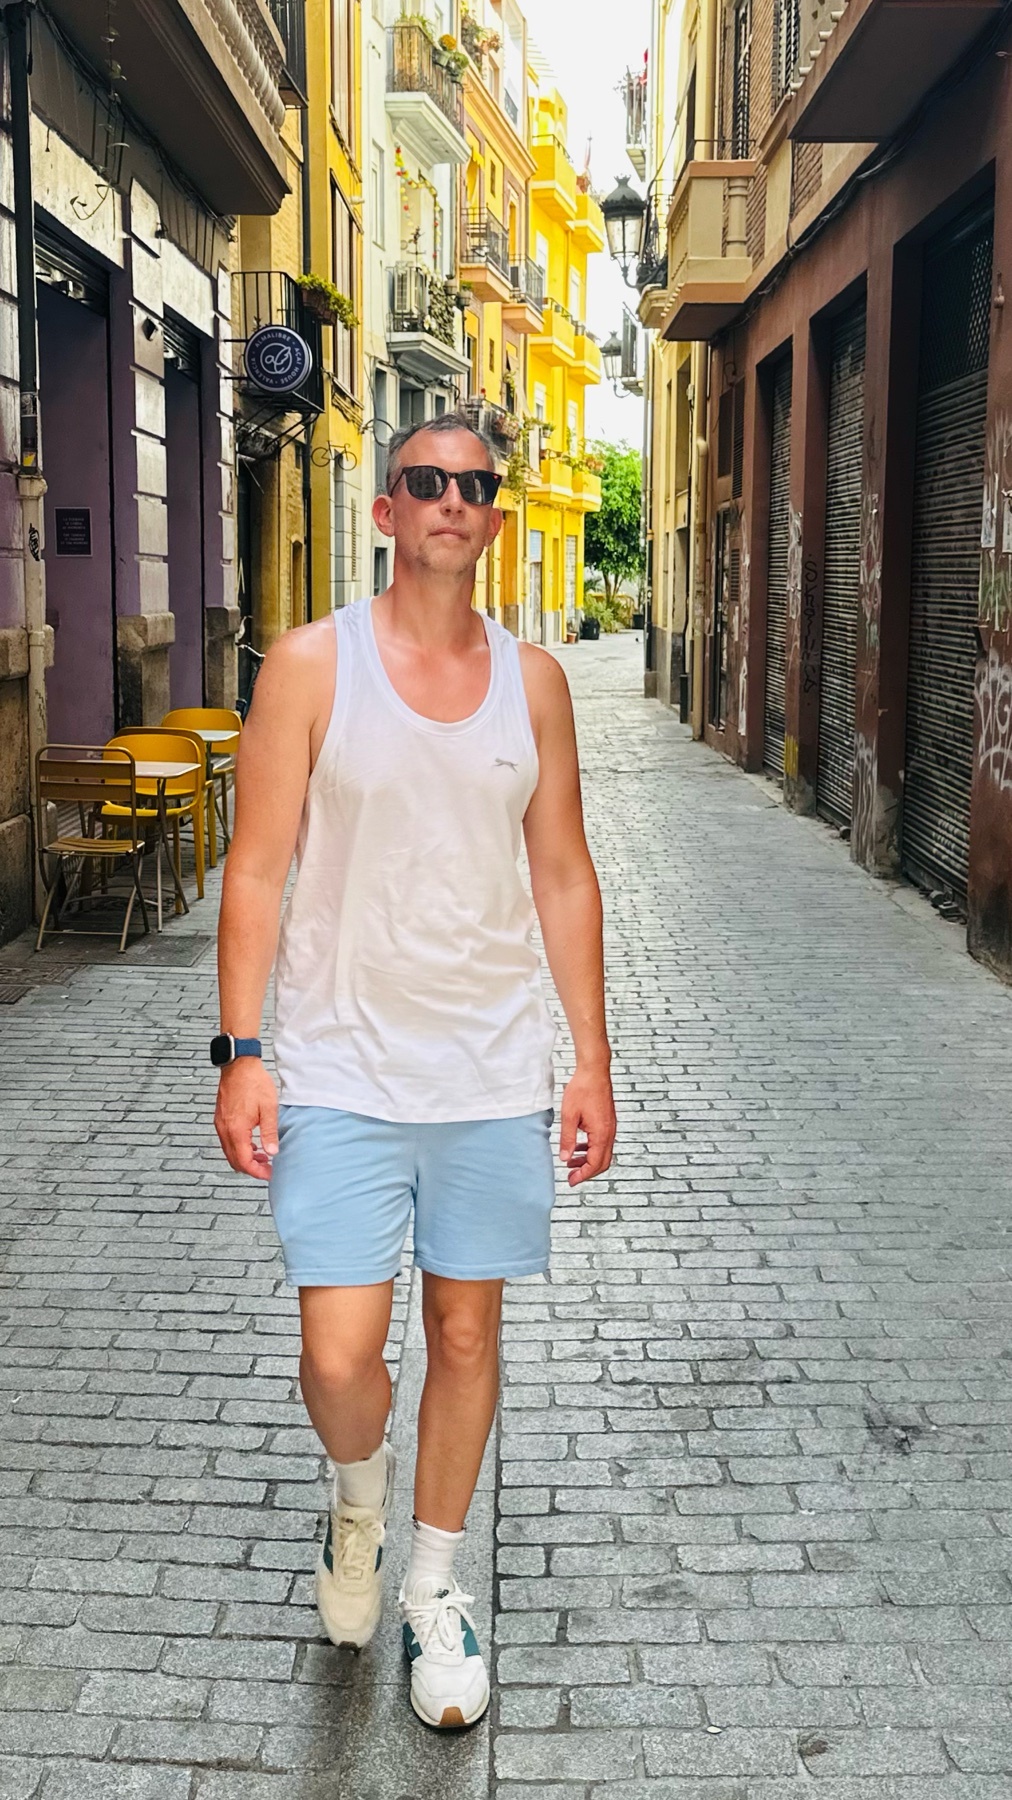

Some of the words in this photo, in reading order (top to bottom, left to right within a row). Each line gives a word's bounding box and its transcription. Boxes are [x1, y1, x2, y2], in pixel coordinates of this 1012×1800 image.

[255, 332, 291, 348] ALMALIBRE
[251, 357, 274, 384] VALENCIA
[280, 367, 300, 384] HOUSE
